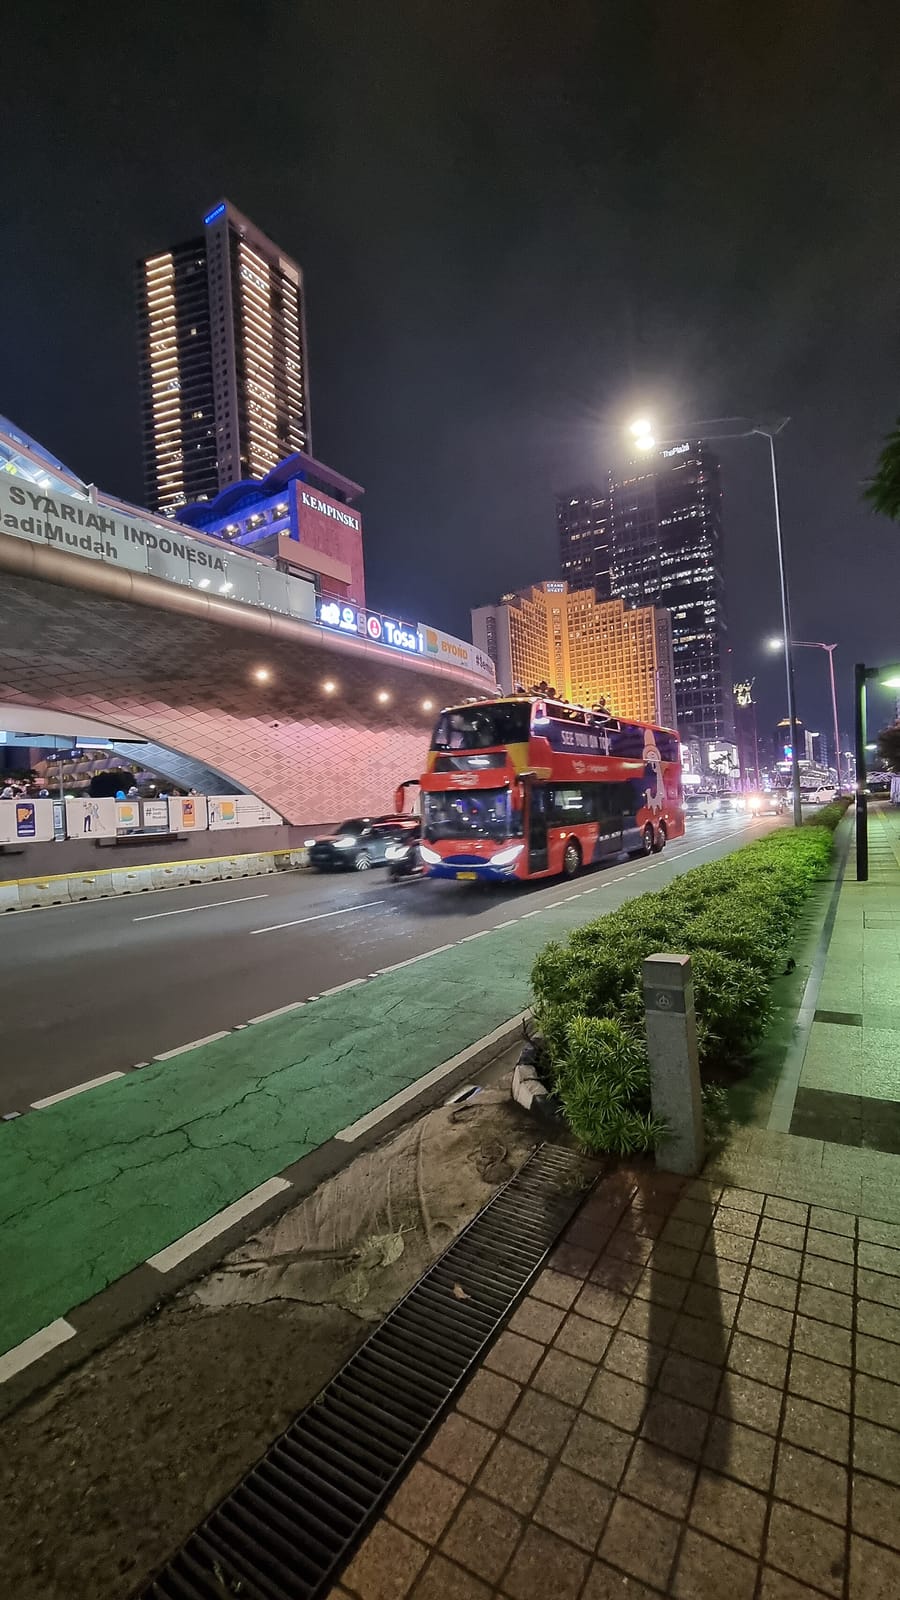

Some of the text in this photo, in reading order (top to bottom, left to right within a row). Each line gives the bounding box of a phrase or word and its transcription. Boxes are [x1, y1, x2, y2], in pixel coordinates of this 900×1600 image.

[0, 507, 118, 559] adiMudah
[9, 486, 225, 572] SYARIAH INDONESIA
[302, 492, 359, 530] KEMPINSKI
[441, 640, 468, 660] BYOND
